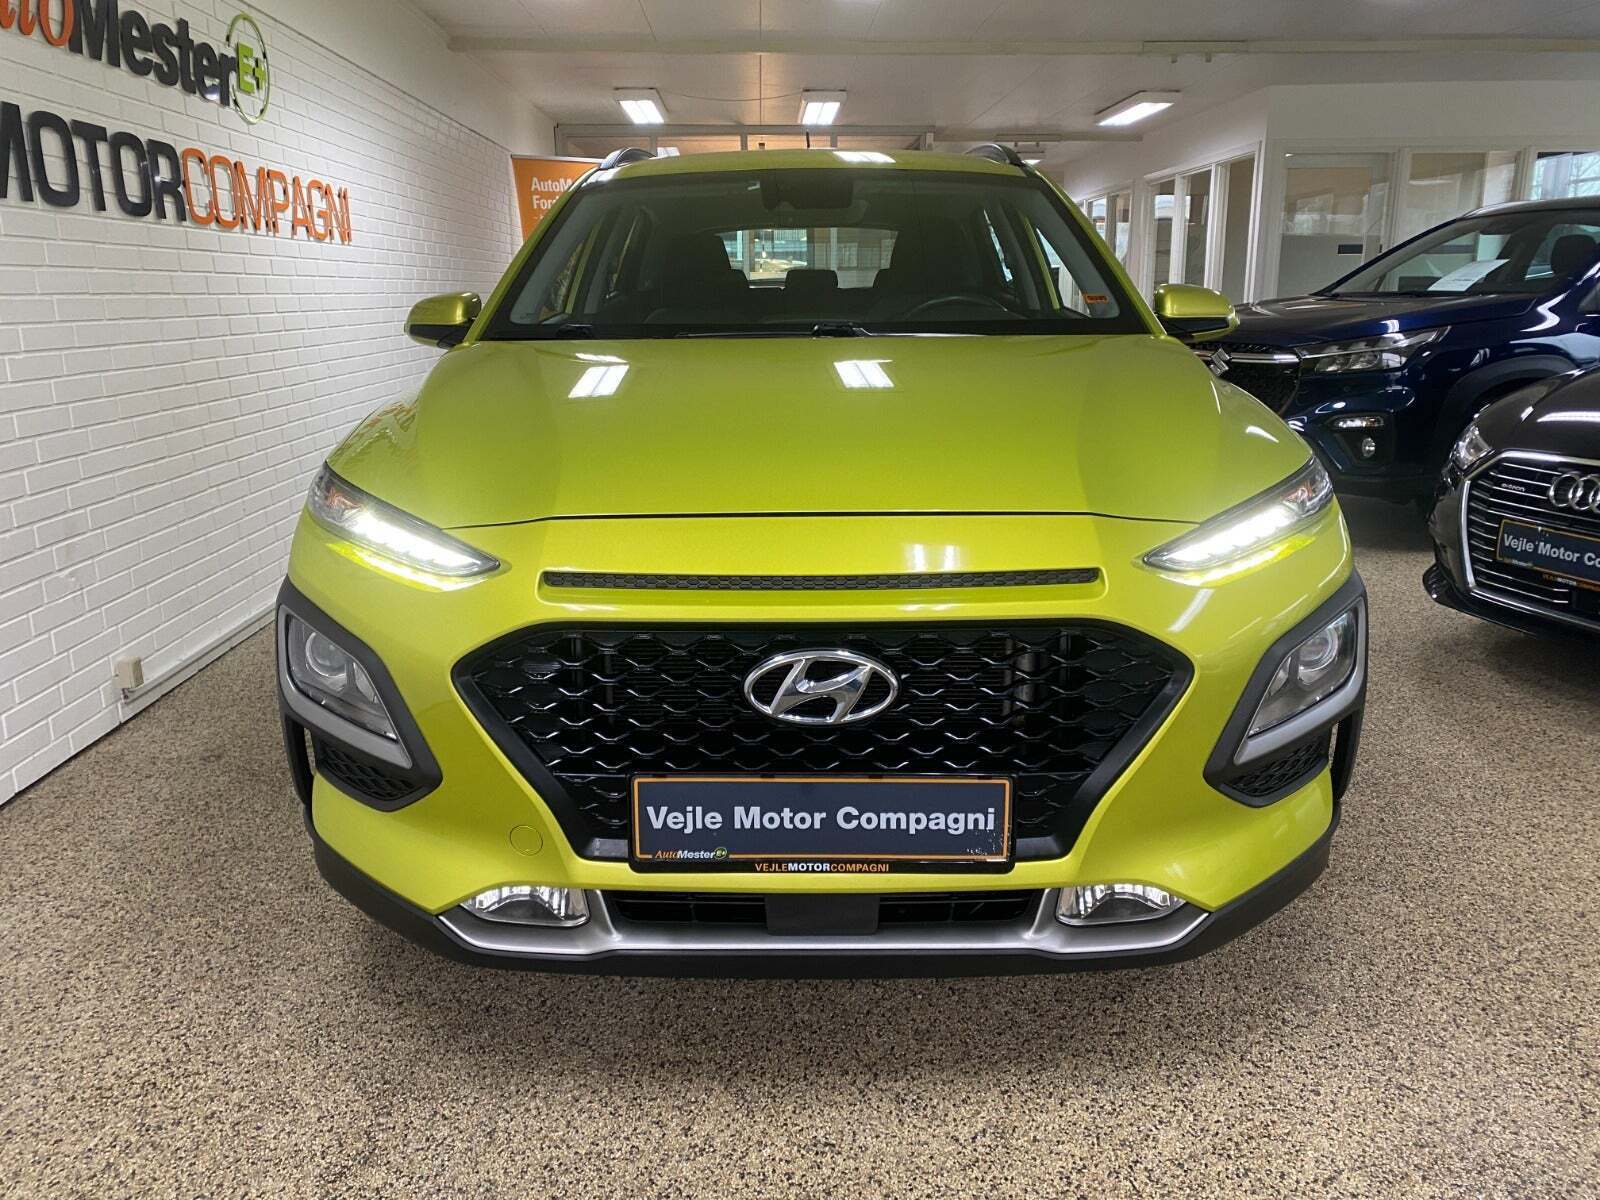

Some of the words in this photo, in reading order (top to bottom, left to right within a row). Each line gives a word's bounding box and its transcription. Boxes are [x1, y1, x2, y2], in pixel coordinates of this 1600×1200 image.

[1504, 533, 1535, 552] Vejle
[1537, 541, 1580, 562] Motor
[646, 806, 723, 834] Vejle
[734, 806, 827, 830] Motor
[836, 806, 995, 835] Compagni
